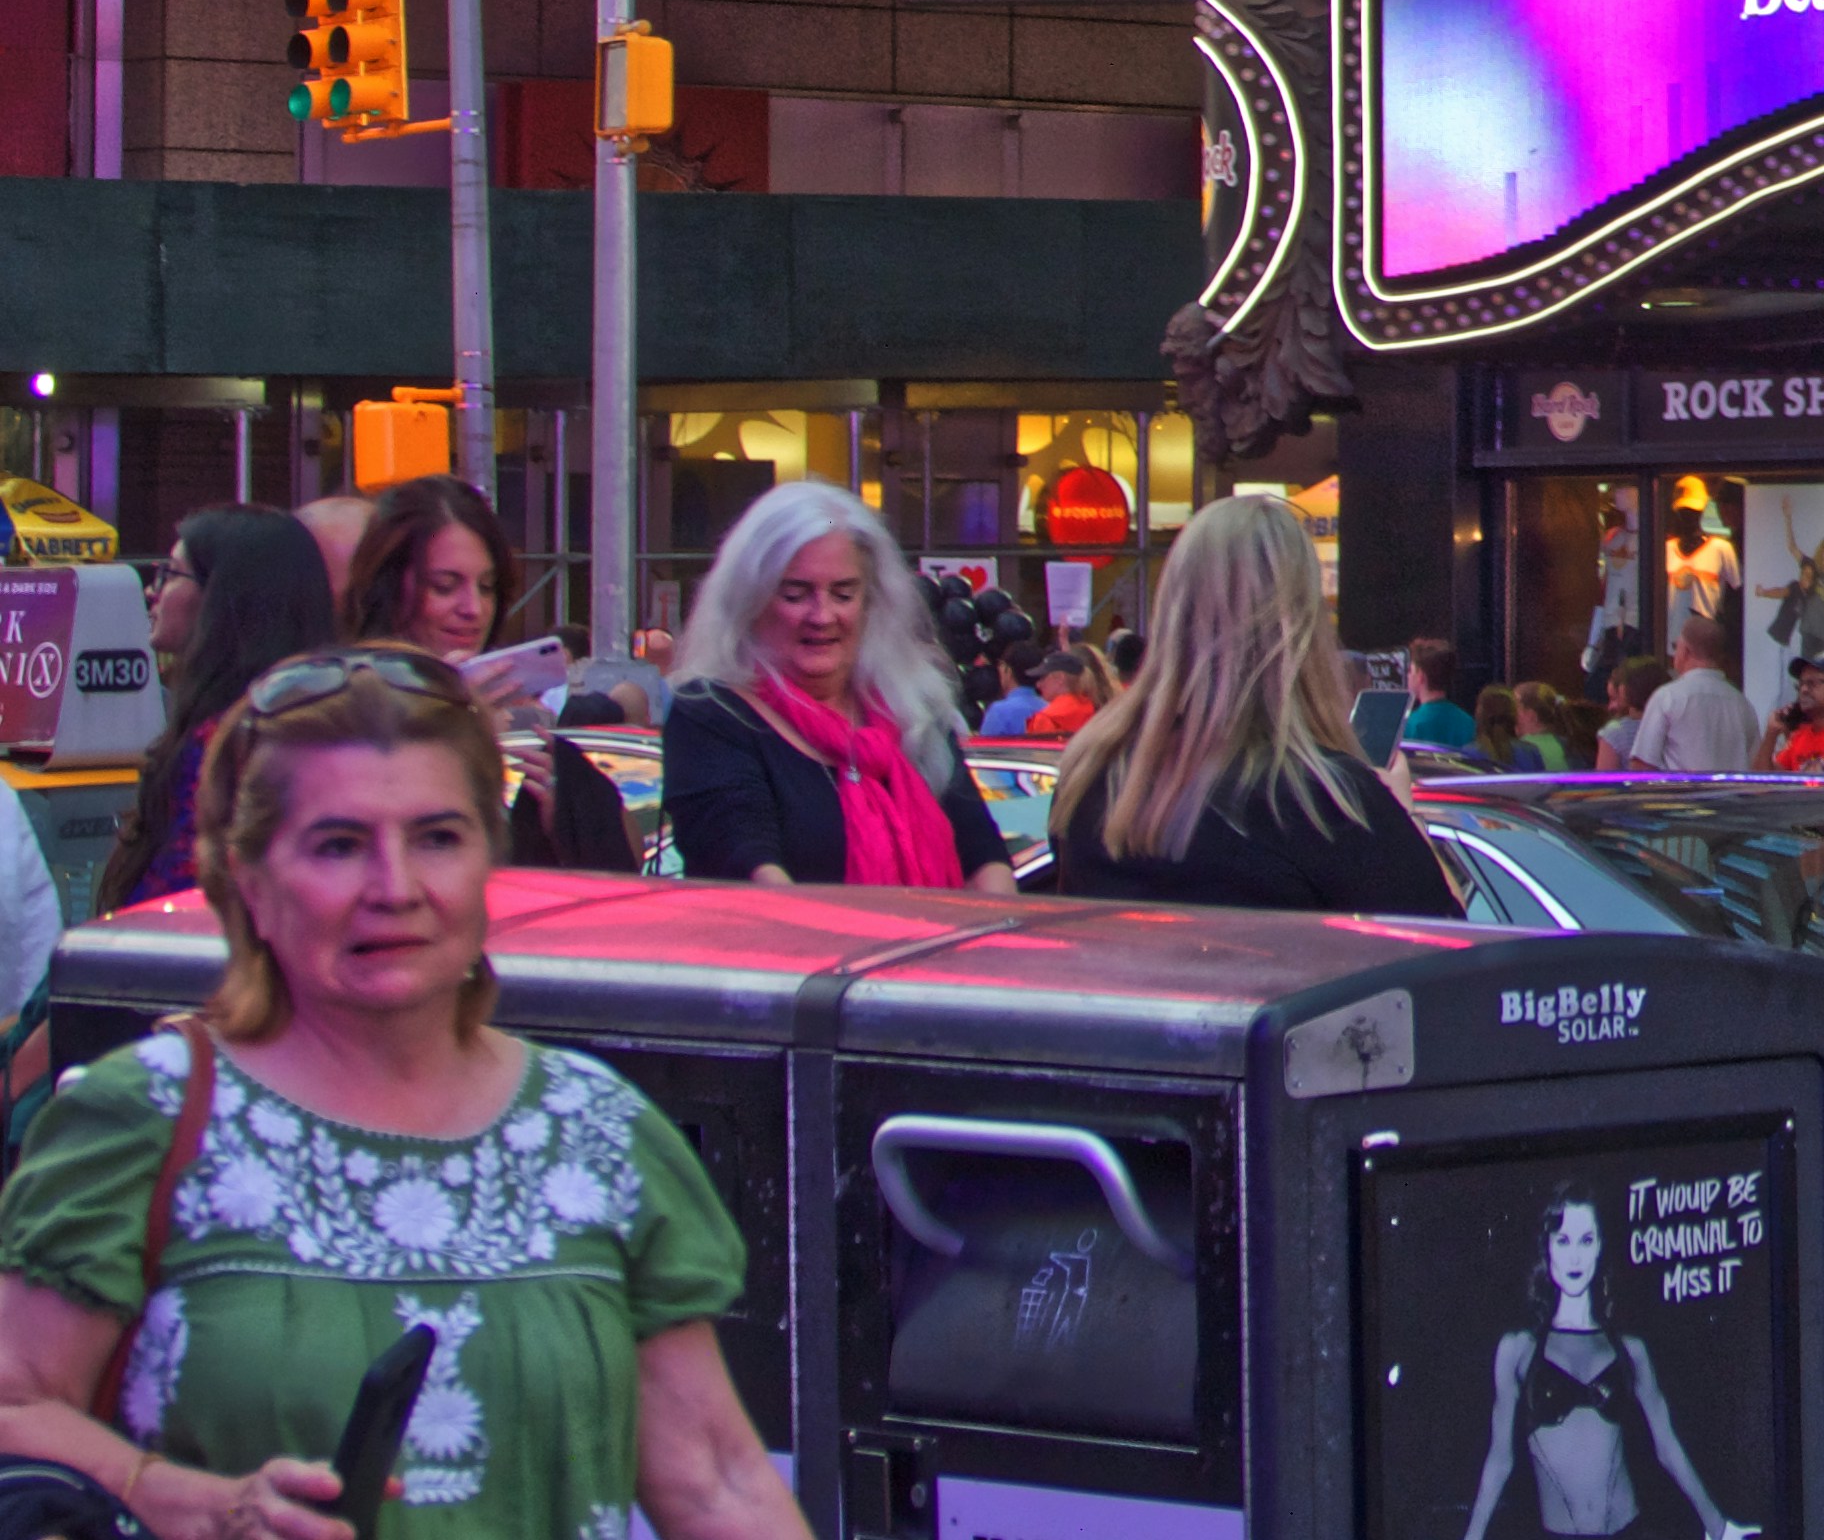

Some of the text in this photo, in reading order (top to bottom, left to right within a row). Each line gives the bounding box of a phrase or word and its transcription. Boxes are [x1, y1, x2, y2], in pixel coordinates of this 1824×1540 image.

[1662, 379, 1774, 420] ROCK
[76, 658, 148, 687] 3M30
[1501, 982, 1646, 1027] BigBelly
[1629, 1171, 1762, 1221] IT WOULD BE
[1630, 1211, 1762, 1263] CRIMINAL TO
[1664, 1258, 1742, 1303] MISS IT
